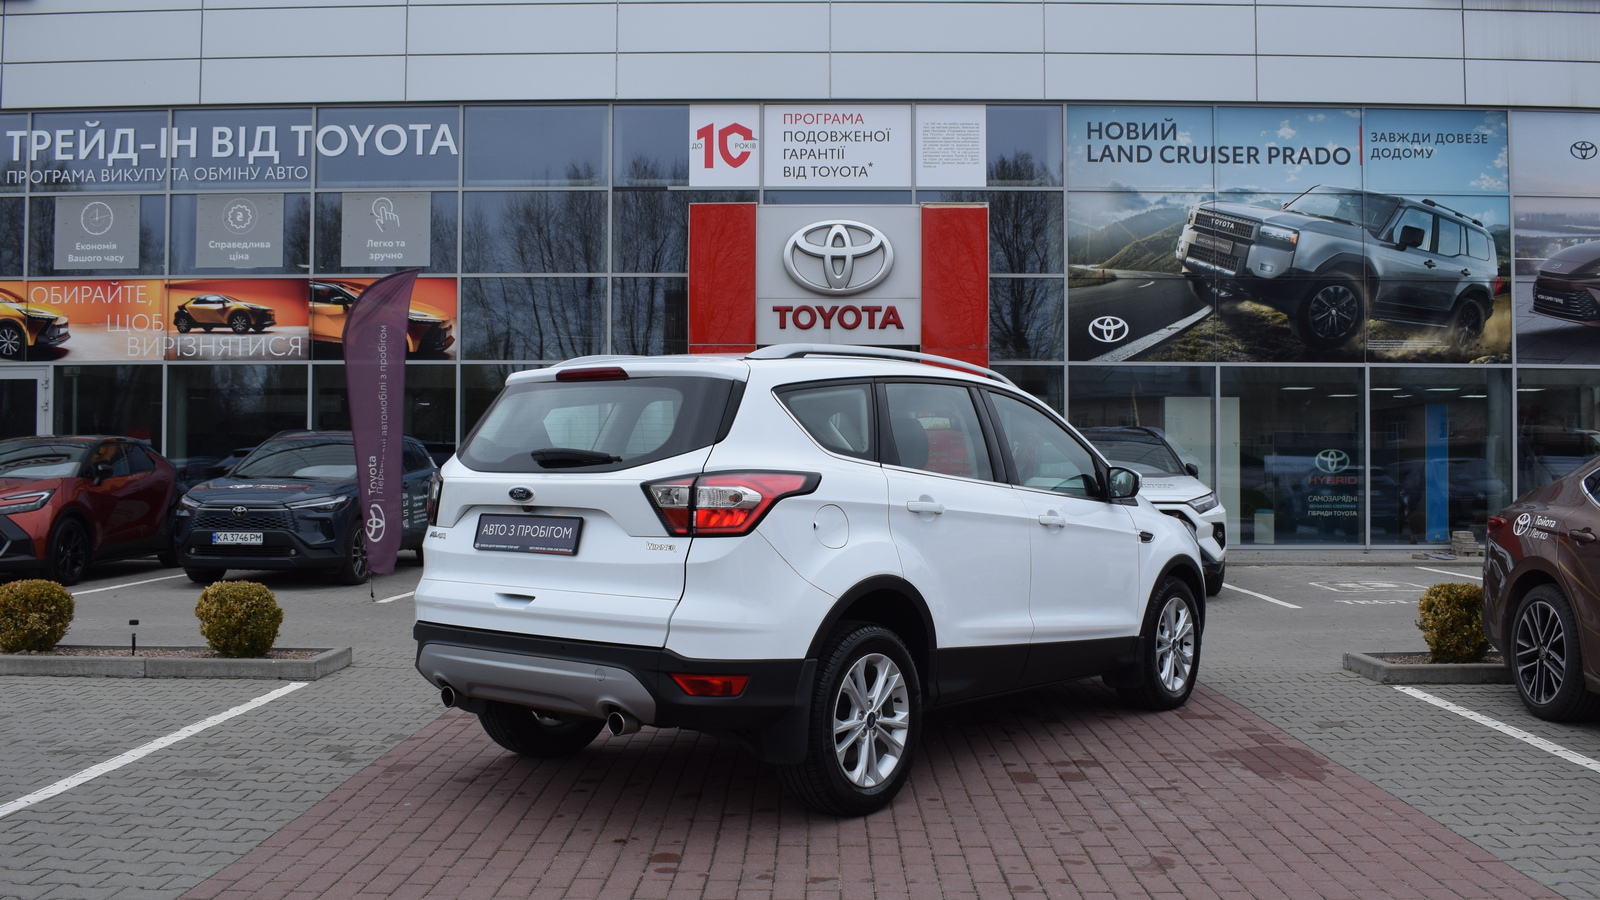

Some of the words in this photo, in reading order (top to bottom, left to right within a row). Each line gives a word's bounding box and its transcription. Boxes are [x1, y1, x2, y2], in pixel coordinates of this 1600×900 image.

[783, 113, 865, 125] ПРОГРАМА
[783, 127, 892, 145] ПОДОВЖЕНОЇ
[1086, 117, 1177, 141] НОВИЙ
[6, 120, 198, 167] ТРЕЙД-ІН
[212, 126, 280, 165] ВІД
[291, 123, 459, 157] TOYOTA
[1370, 131, 1431, 146] ЗАВЖДИ
[1435, 132, 1489, 146] ДОВЕЗЕ
[691, 142, 703, 151] ДО
[734, 142, 757, 150] РОКІВ
[783, 145, 847, 160] ГАРАНТІЇ
[1370, 147, 1434, 161] ДОДОМУ
[1086, 144, 1153, 164] LAND
[1159, 144, 1260, 166] CRUISER
[1267, 146, 1352, 167] PRADO
[6, 169, 97, 184] ПРОГРАМА
[101, 168, 167, 183] ВИКУПУ
[171, 167, 189, 181] ТА
[193, 166, 261, 182] ОБМІНУ
[264, 166, 309, 181] АВТО
[783, 165, 807, 180] ВІД
[1210, 218, 1235, 229] TOYOTA
[75, 241, 118, 251] Економія
[208, 240, 271, 250] Справедлива
[366, 239, 394, 248] Легко
[396, 240, 406, 248] та
[68, 254, 102, 262] Вашого
[104, 255, 125, 264] часу
[229, 252, 250, 261] ціна
[368, 252, 404, 261] зручно
[30, 281, 152, 306] ОБИРАЙТЕ,
[107, 313, 164, 335] ЩОБ
[772, 305, 904, 330] TOYOTA
[127, 336, 303, 358] ВИРІЗНЯТИСЯ
[378, 324, 389, 372] пробігом
[378, 382, 388, 436] автомобілі
[368, 455, 377, 496] Toyota
[1308, 475, 1358, 485] HYBRID
[1307, 494, 1358, 503] САМОЗАРЯДНІ
[230, 533, 249, 542] 3746
[481, 523, 507, 536] АВТО
[508, 524, 516, 536] З
[517, 524, 573, 539] ПРОБІГОМ
